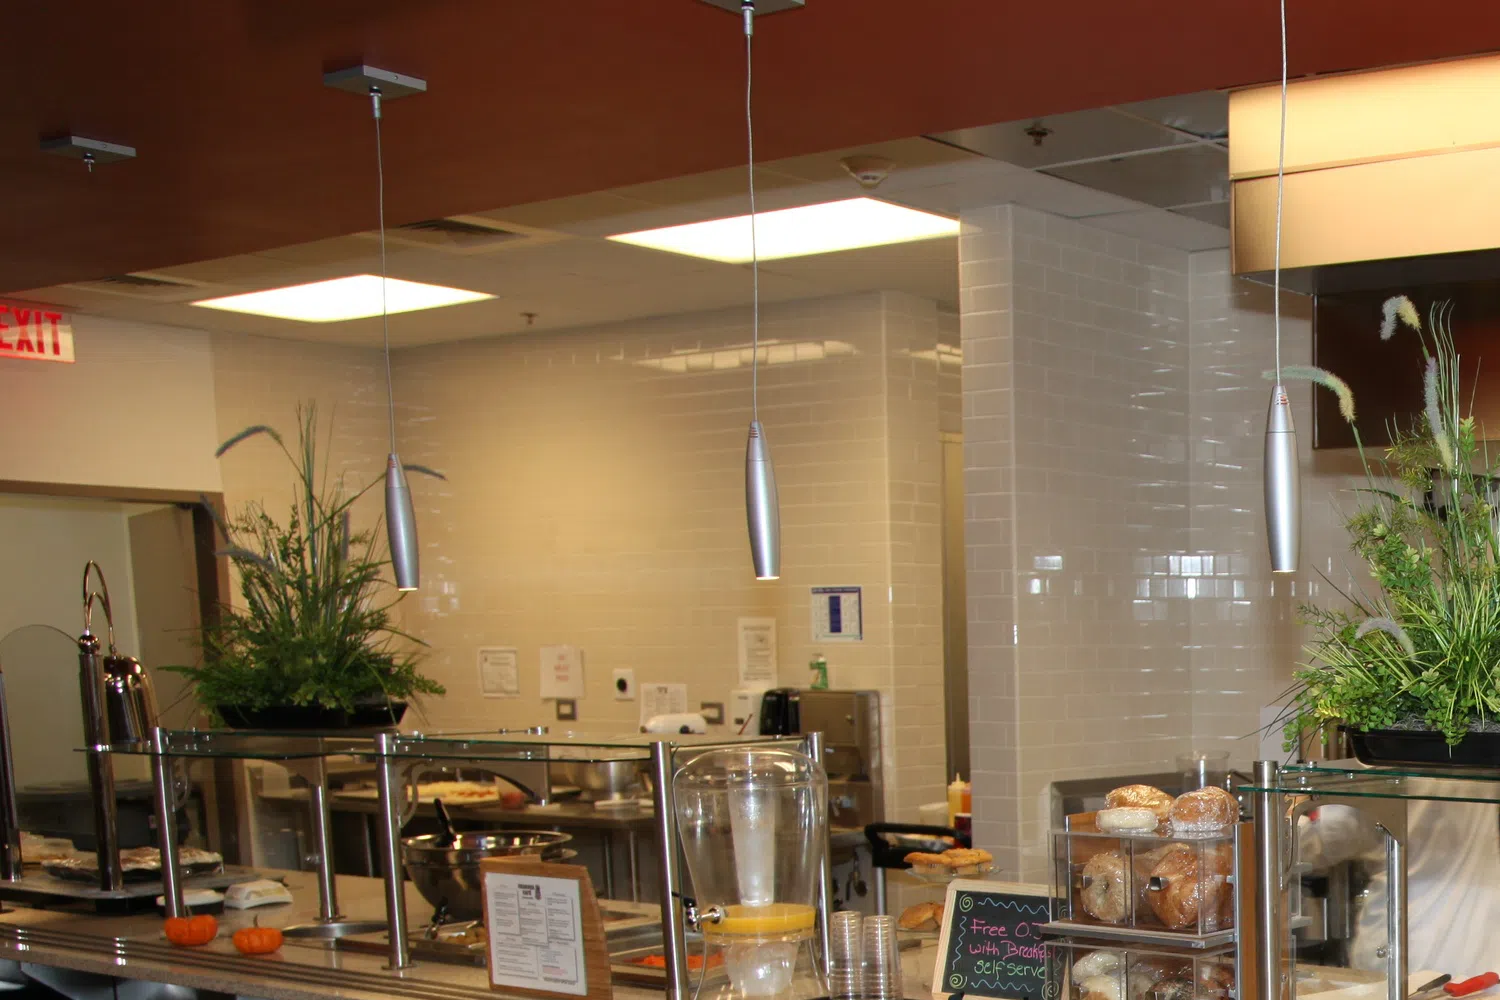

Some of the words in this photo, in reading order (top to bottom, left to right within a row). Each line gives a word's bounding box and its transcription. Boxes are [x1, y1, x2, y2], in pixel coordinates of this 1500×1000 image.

[0, 304, 63, 356] EXIT
[970, 918, 1008, 936] Free
[969, 940, 999, 956] with
